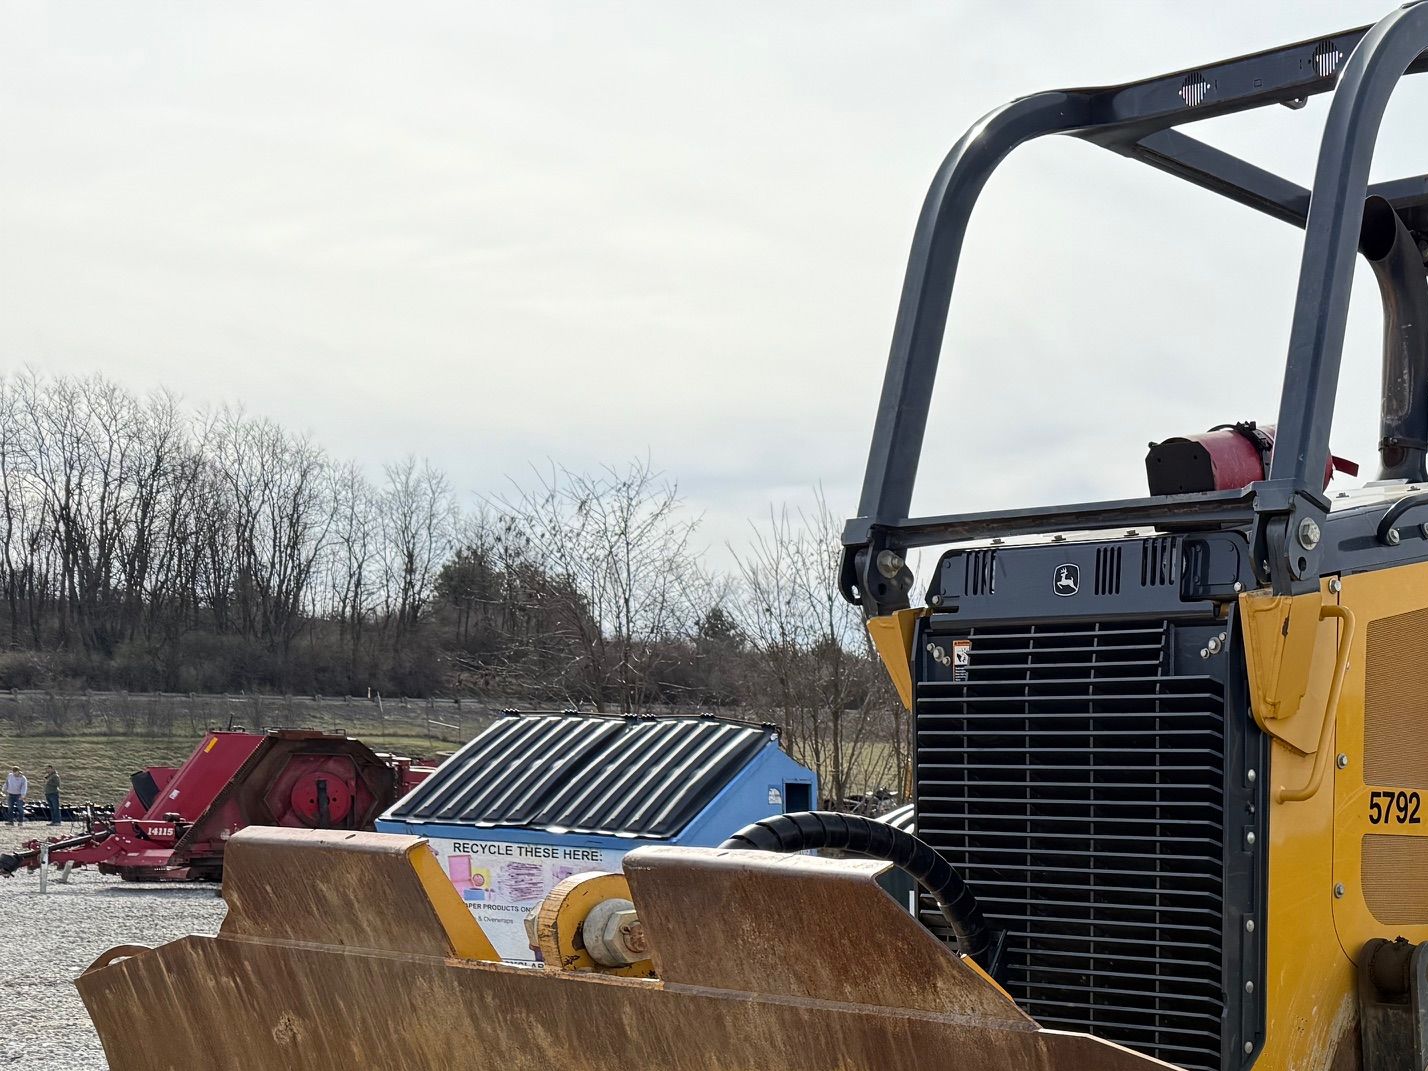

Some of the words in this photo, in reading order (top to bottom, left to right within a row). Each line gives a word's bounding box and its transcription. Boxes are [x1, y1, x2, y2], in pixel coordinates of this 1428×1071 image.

[1368, 790, 1421, 824] 5792
[147, 827, 174, 836] 14115
[453, 842, 513, 856] RECYCLE
[517, 846, 559, 859] THESE
[563, 850, 603, 862] HERE:
[483, 904, 519, 913] PRODUCTS
